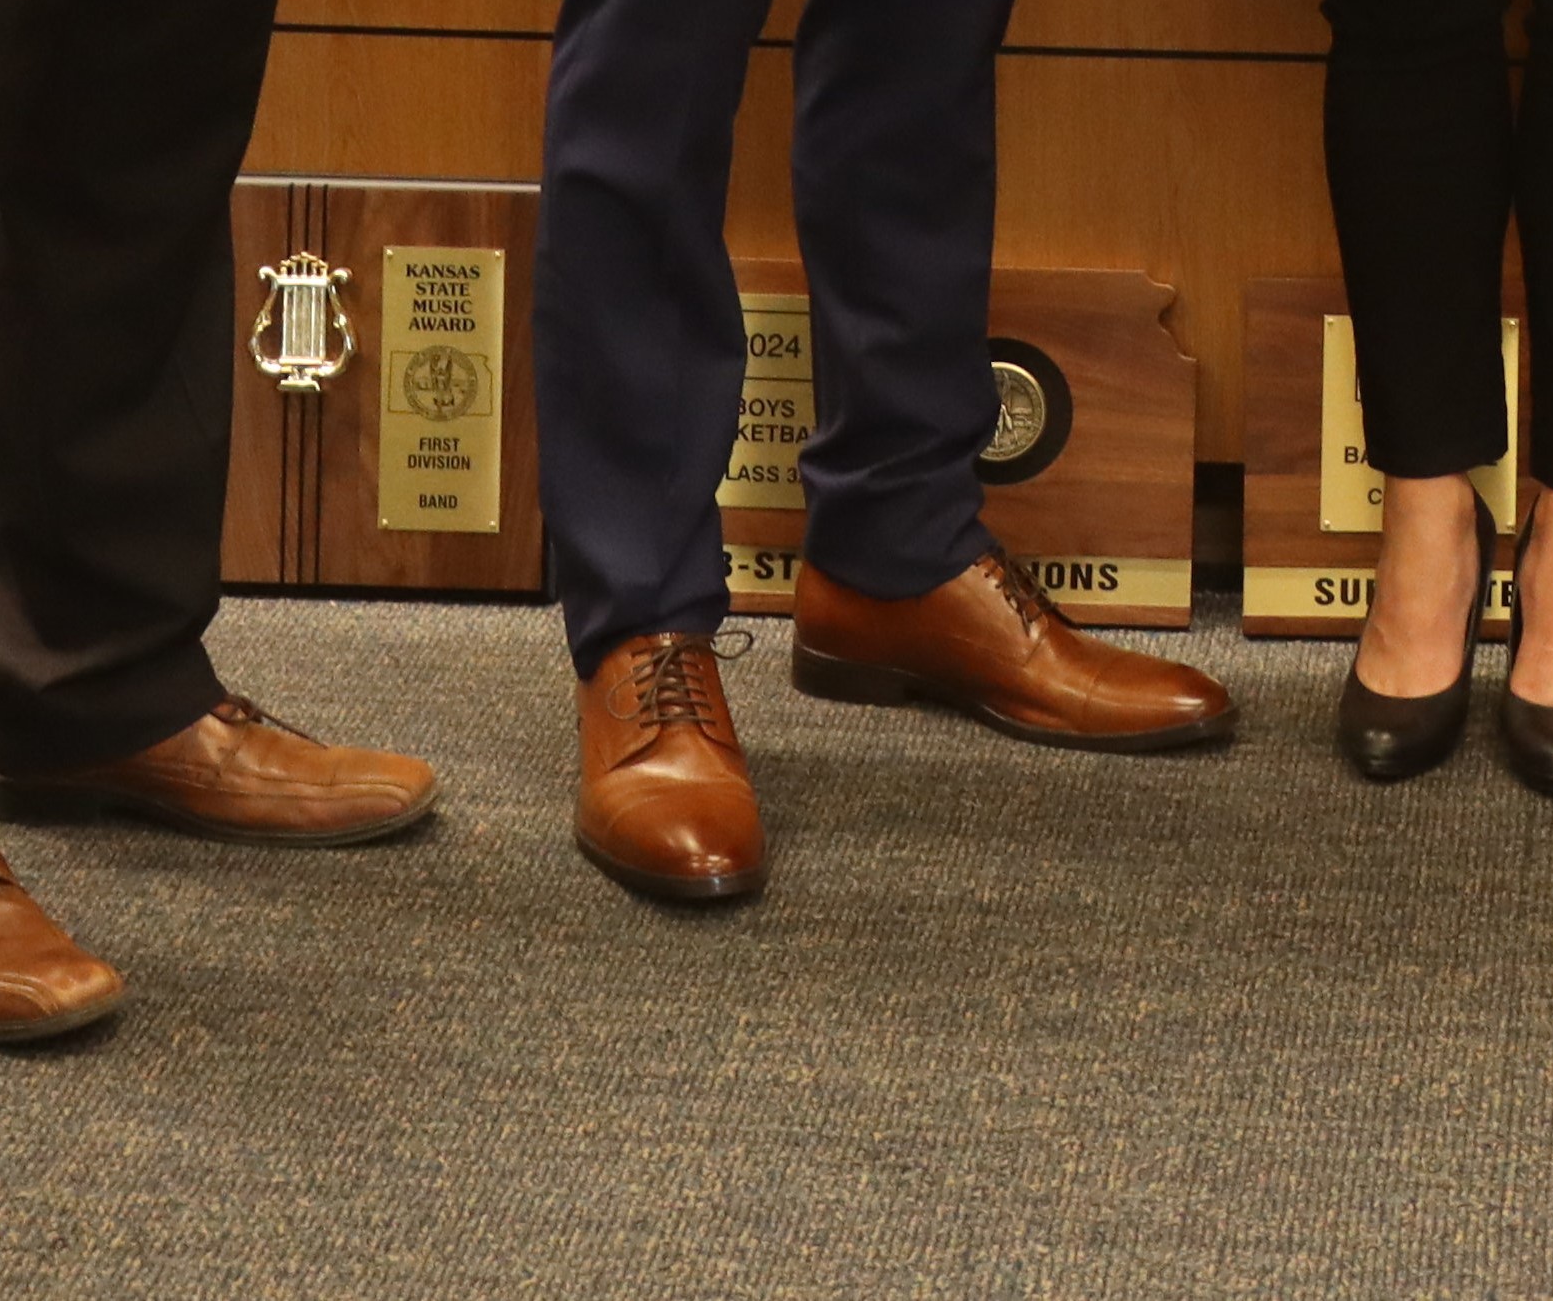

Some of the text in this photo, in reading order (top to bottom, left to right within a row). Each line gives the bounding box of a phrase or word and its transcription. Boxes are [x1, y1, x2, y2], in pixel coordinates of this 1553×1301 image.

[405, 263, 481, 279] KANSAS
[415, 281, 470, 297] STATE
[412, 299, 473, 314] MUSIC
[408, 317, 476, 333] AWARD
[747, 333, 802, 359] 024
[419, 437, 461, 453] FIRST
[407, 454, 471, 471] DIVISION
[418, 493, 459, 509] BAND
